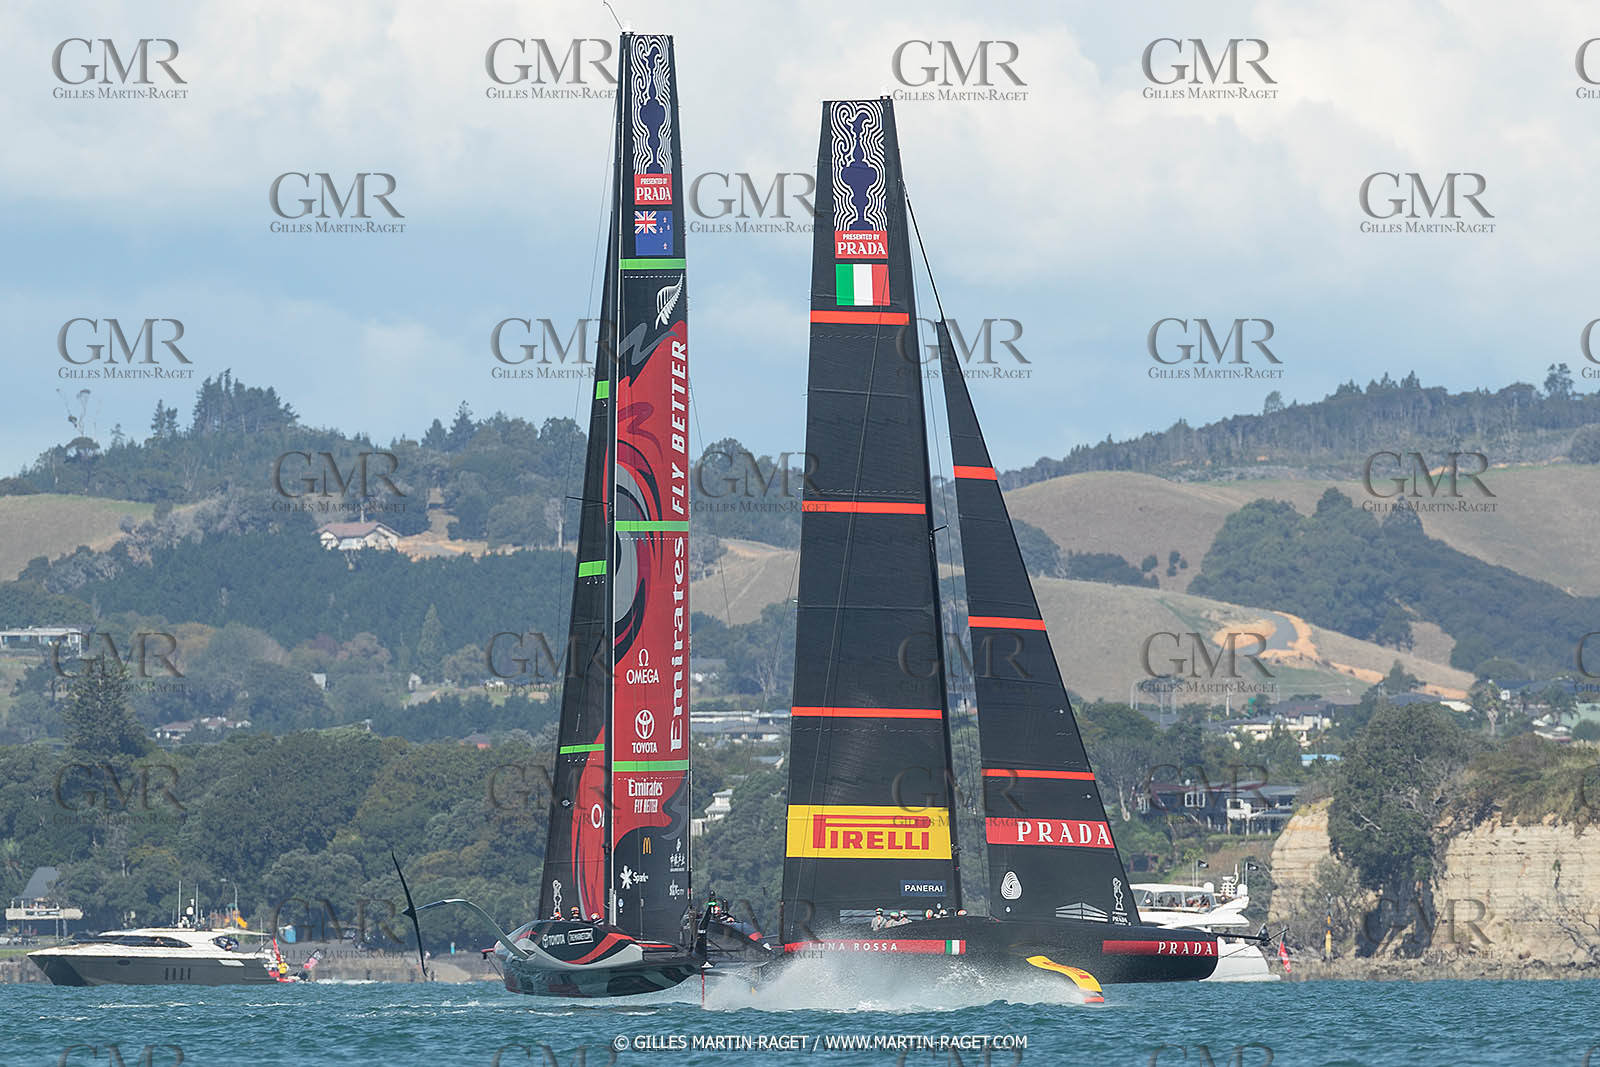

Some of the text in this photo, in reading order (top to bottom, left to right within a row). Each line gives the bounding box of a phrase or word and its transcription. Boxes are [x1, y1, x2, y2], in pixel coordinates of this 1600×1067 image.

[636, 187, 672, 200] PRADA
[838, 242, 886, 254] PRADA
[670, 340, 686, 752] Emirates FLY BETTER
[626, 669, 660, 684] OMEGA
[632, 742, 658, 753] TOYOTA
[628, 779, 663, 796] Emirates
[812, 814, 931, 850] PIRELLI
[1016, 822, 1110, 845] PRADA
[904, 884, 943, 892] PANERAI
[810, 942, 898, 950] LUNA ROSSA
[1157, 942, 1213, 954] PRADA
